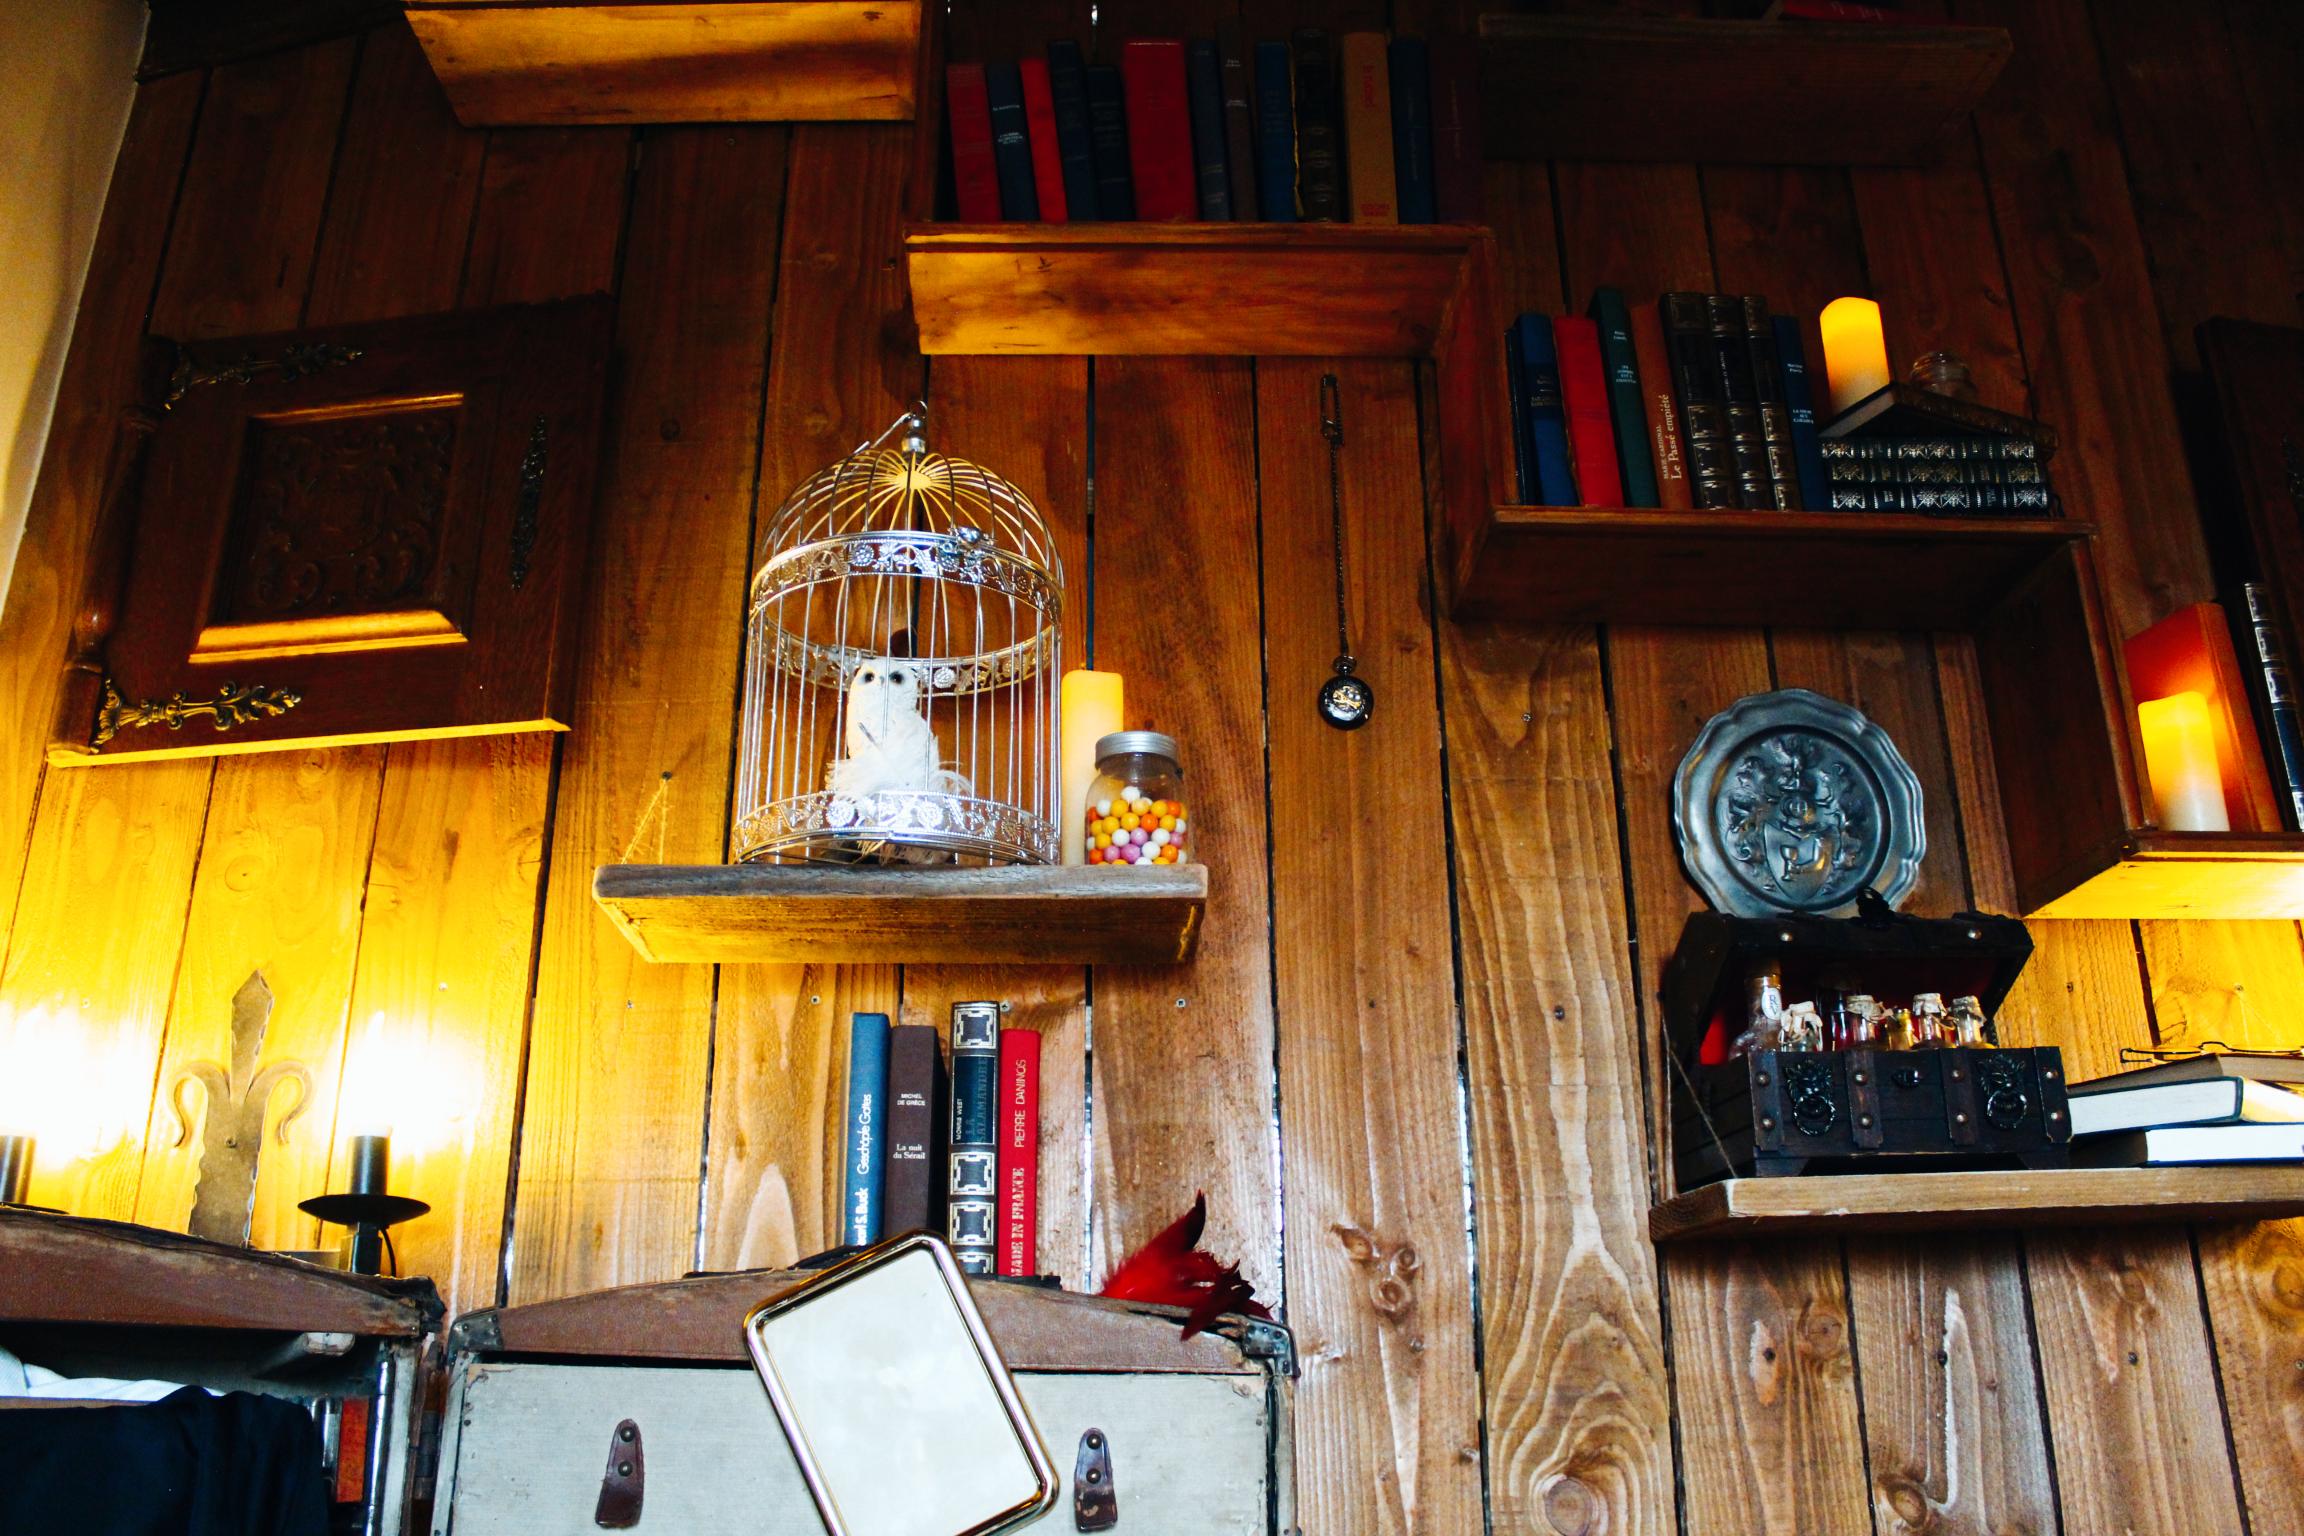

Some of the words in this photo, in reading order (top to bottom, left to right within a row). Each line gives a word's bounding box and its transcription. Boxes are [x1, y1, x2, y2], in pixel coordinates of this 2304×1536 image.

[1658, 394, 1675, 432] empiété
[1665, 435, 1680, 462] Passé
[1671, 465, 1683, 480] Le
[1015, 1060, 1027, 1105] DANINOS
[976, 1057, 988, 1143] SALAMANDRE
[1014, 1109, 1026, 1148] PIERRE
[896, 1143, 907, 1151] La
[908, 1143, 923, 1151] nuit
[903, 1151, 926, 1160] Sérail
[854, 1187, 869, 1215] Buck
[1011, 1167, 1026, 1221] FRANCE
[1011, 1222, 1024, 1239] IN
